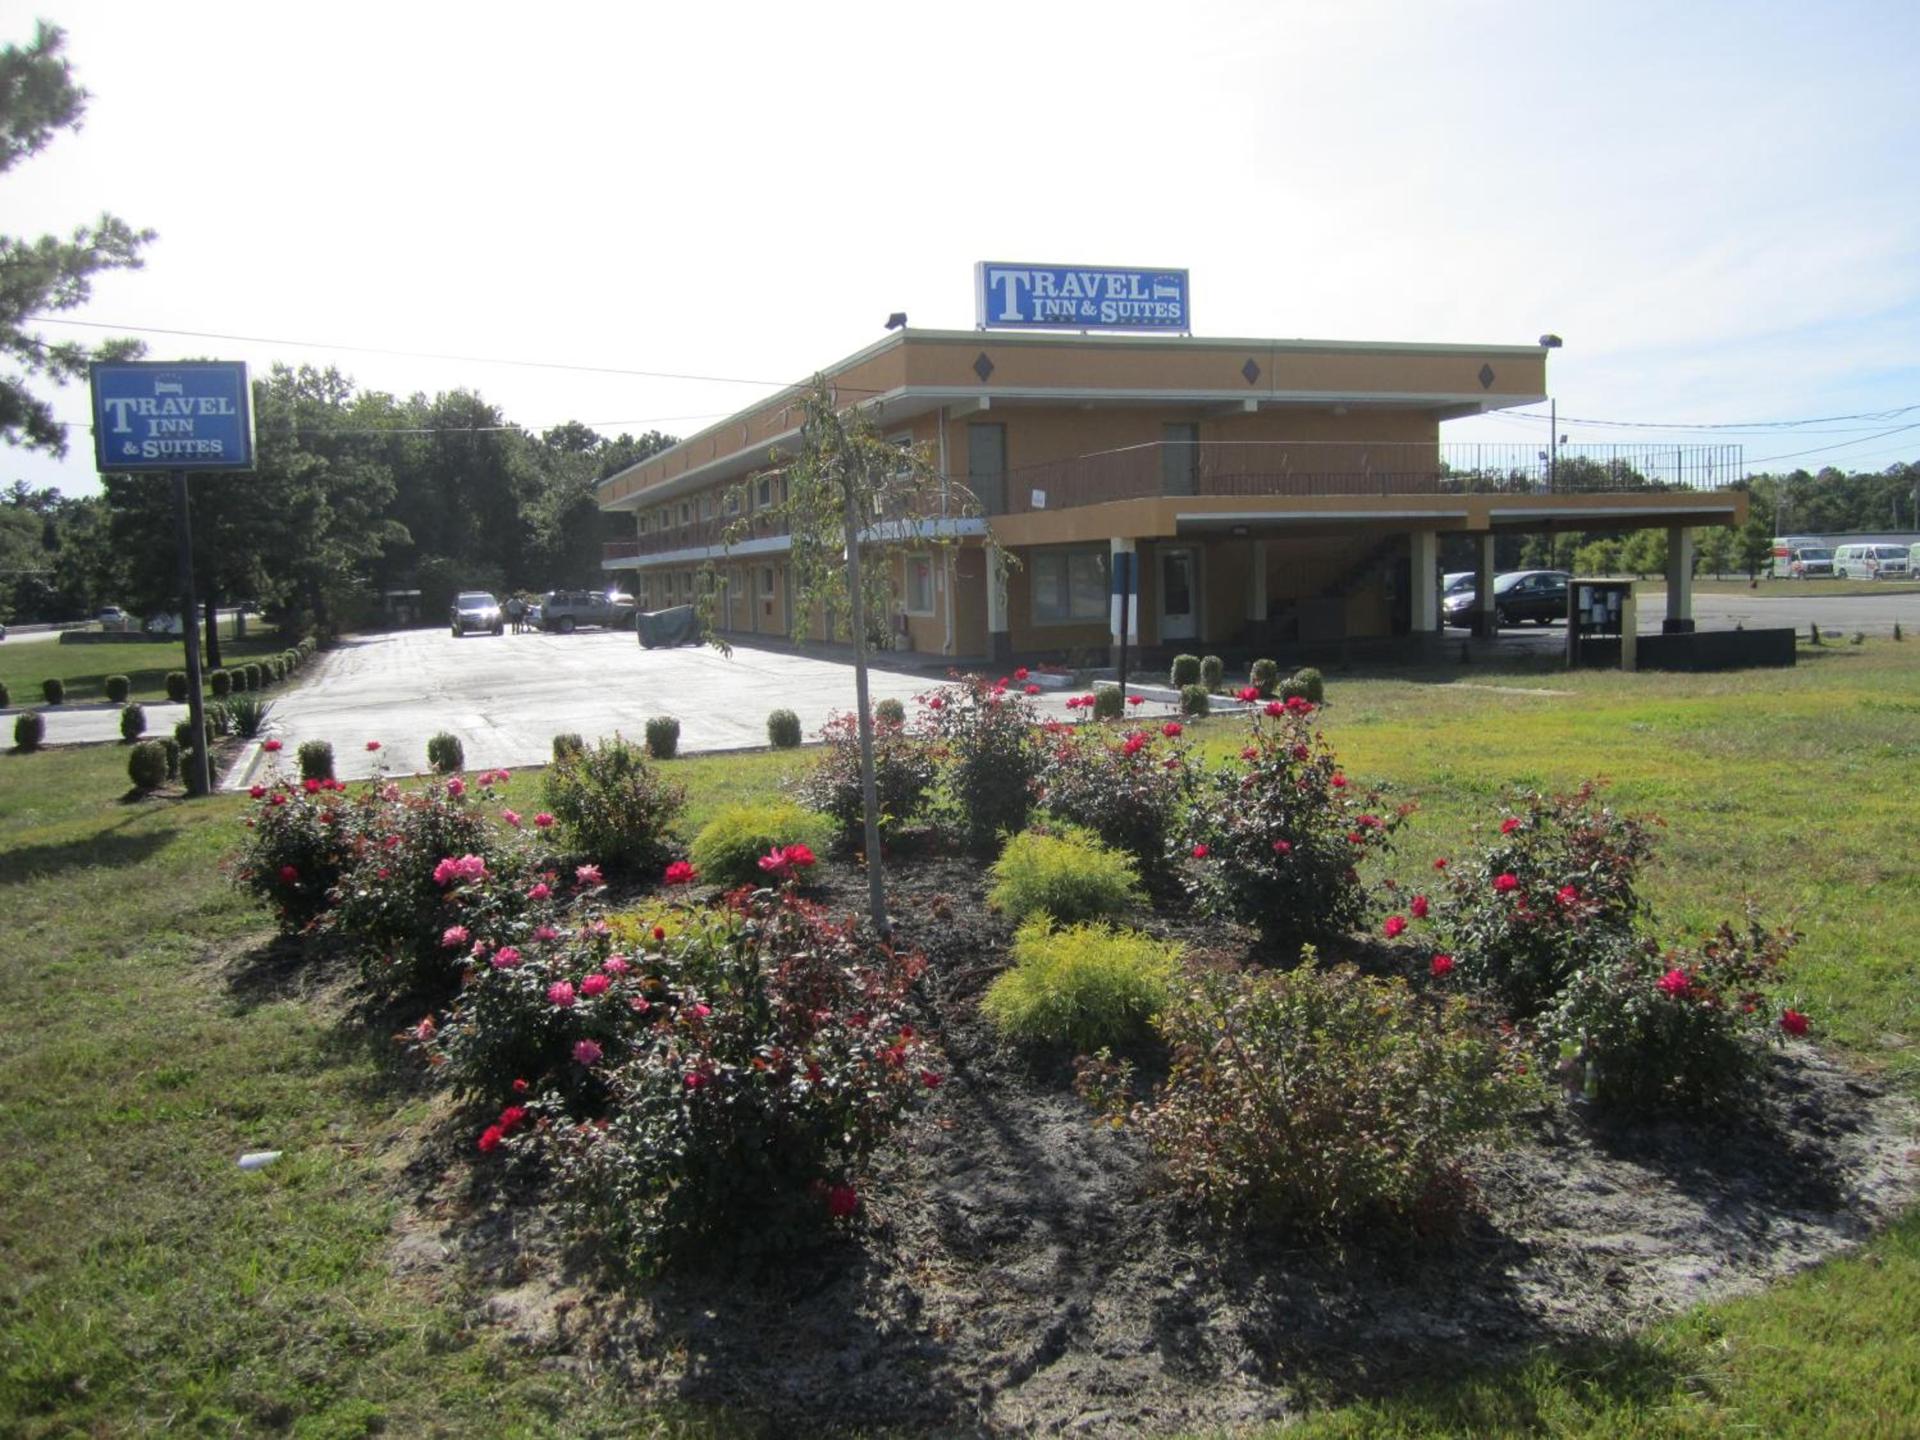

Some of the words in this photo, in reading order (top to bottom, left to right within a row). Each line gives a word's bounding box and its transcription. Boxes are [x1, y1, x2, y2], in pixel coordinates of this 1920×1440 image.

[990, 270, 1149, 321] TRAVEL
[1032, 298, 1076, 321] INN
[1080, 300, 1097, 317] &
[1101, 301, 1181, 323] SUITES
[105, 397, 235, 433] TRAVEL
[148, 419, 194, 436] INN
[142, 439, 223, 458] SUITES
